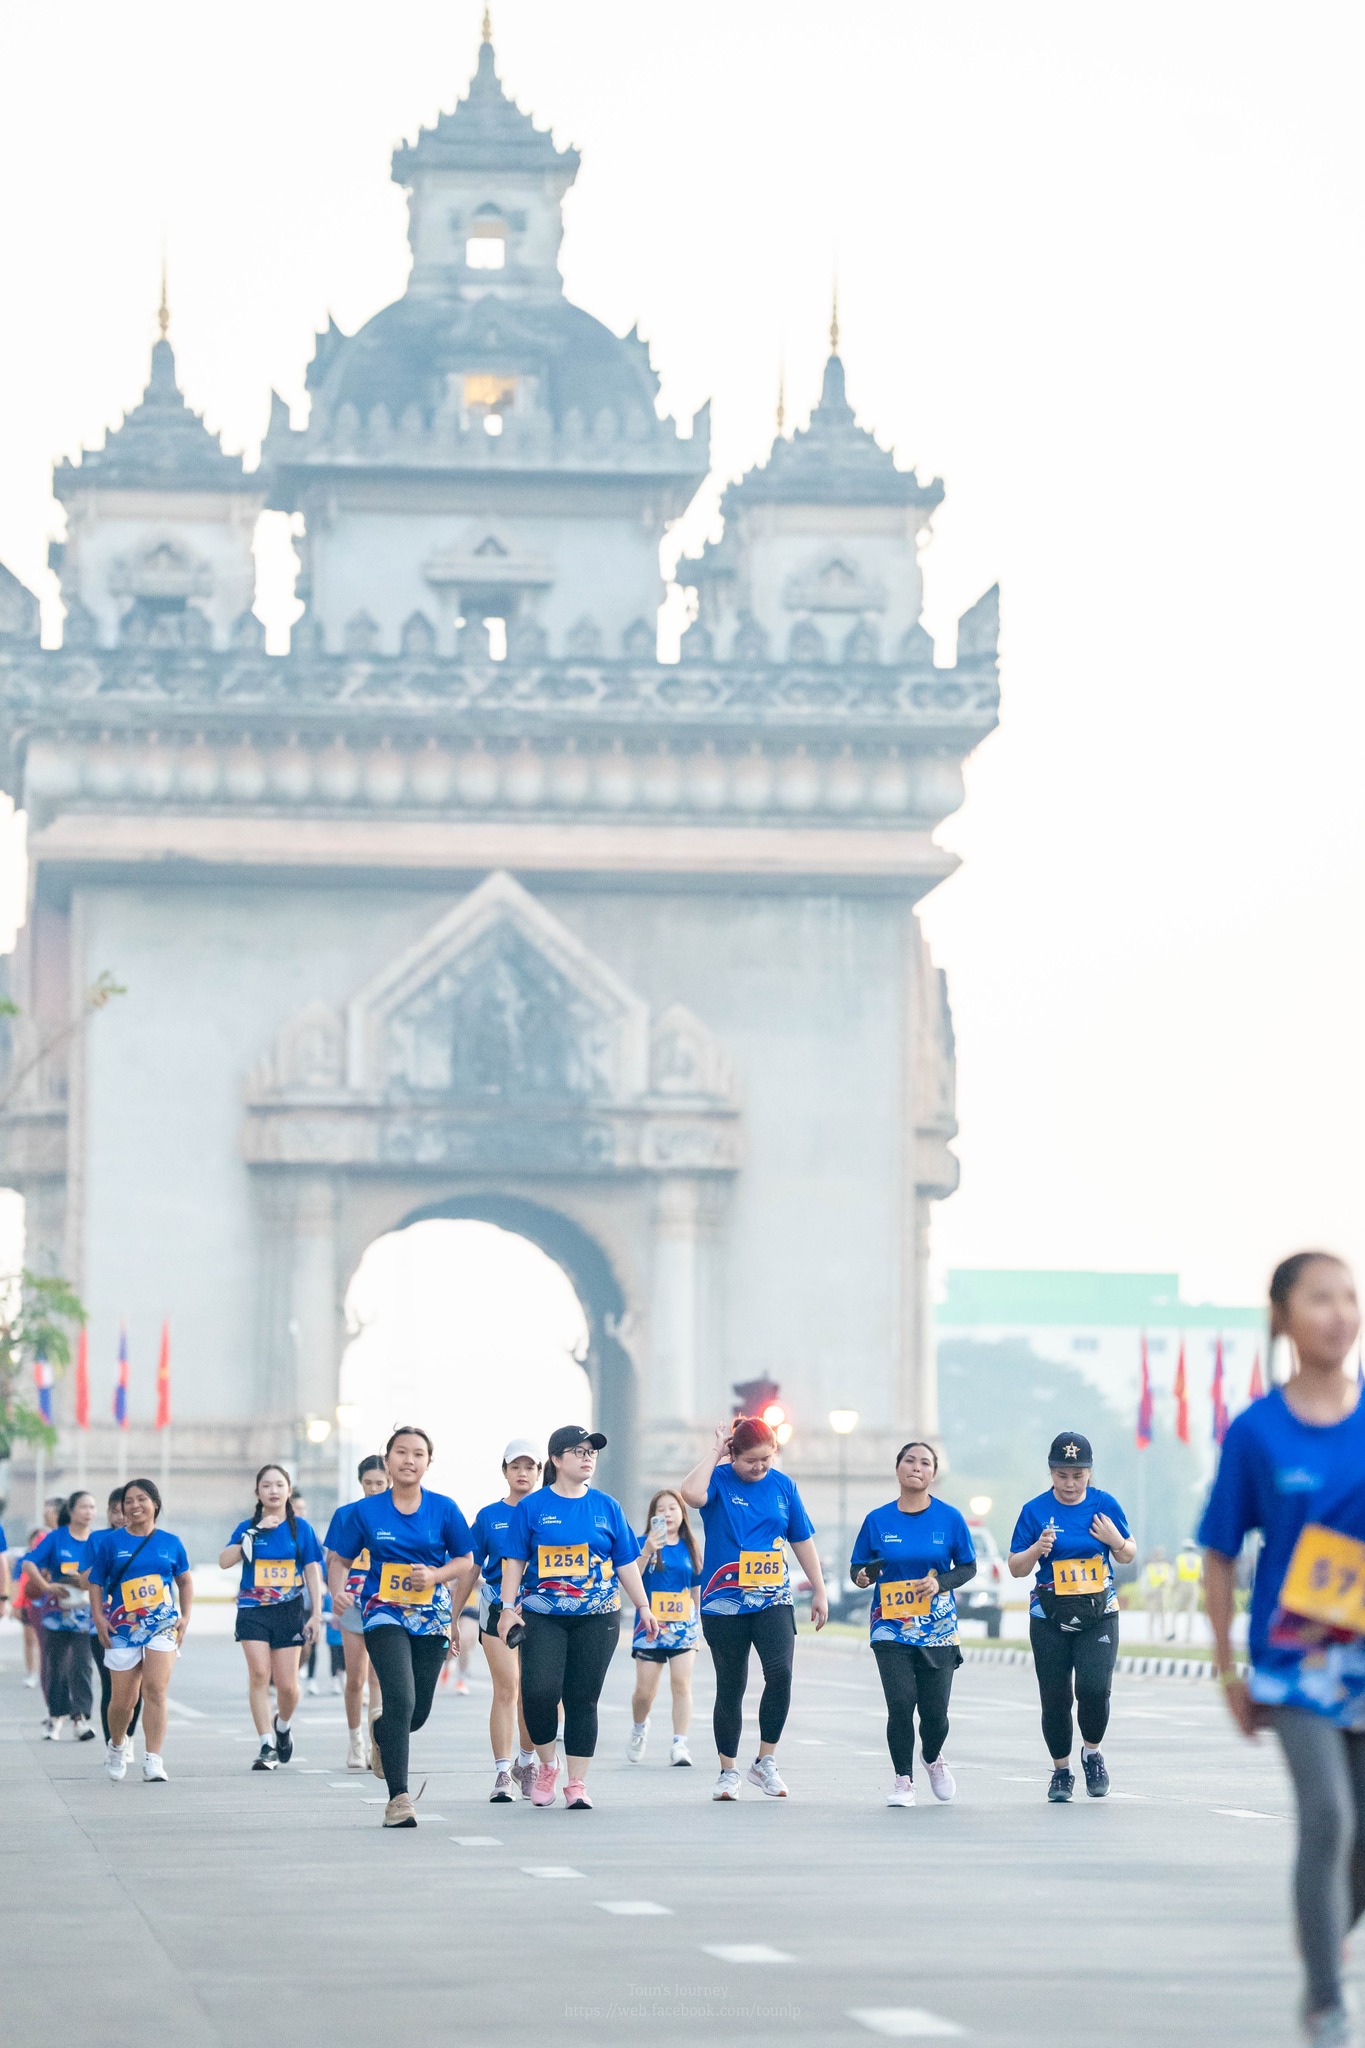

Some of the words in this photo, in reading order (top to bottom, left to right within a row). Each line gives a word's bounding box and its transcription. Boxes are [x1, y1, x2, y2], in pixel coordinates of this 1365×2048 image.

[544, 1554, 584, 1568] 1254
[262, 1567, 288, 1579] 153
[745, 1562, 779, 1574] 1265
[1060, 1568, 1098, 1583] 1111
[130, 1584, 157, 1601] 166
[659, 1601, 683, 1613] 128
